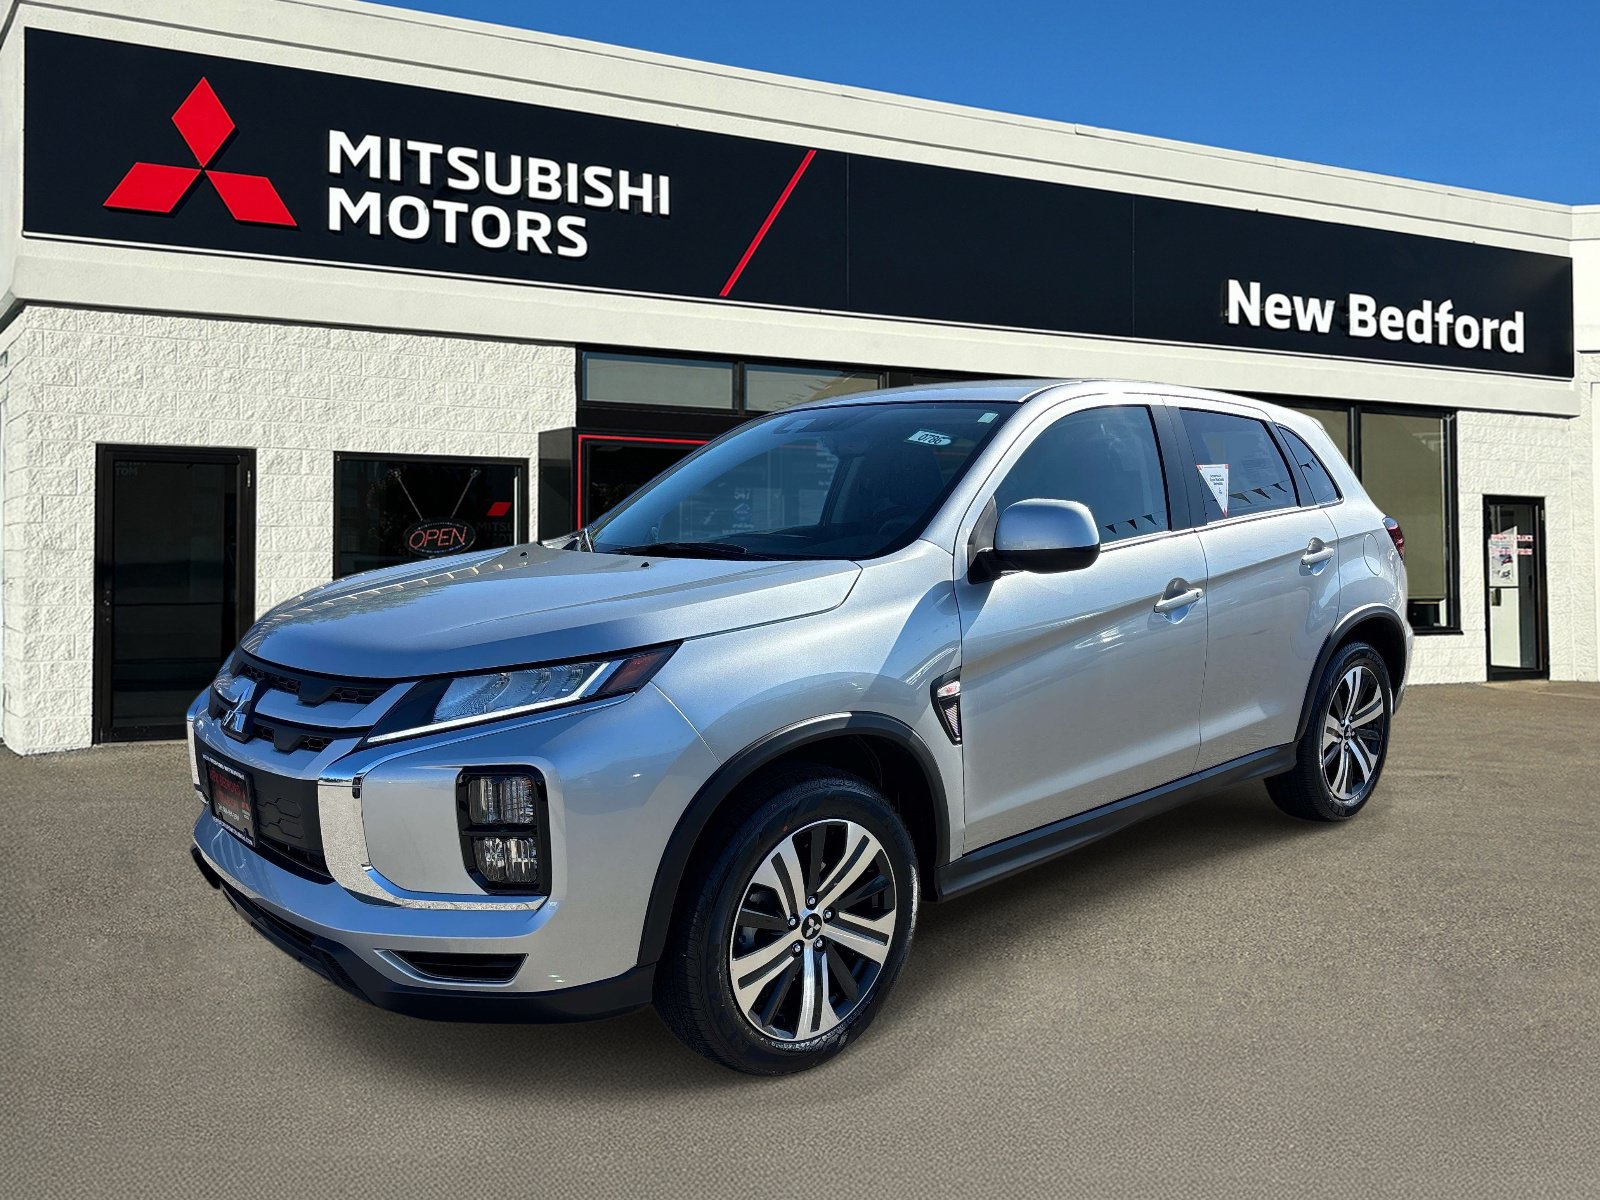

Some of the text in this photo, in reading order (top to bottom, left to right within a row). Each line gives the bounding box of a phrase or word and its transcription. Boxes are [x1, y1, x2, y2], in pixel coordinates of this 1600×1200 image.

[329, 129, 670, 216] MITSUBISHI
[328, 187, 589, 258] MOTORS
[1228, 279, 1525, 354] New Bedford
[409, 526, 467, 549] OPEN
